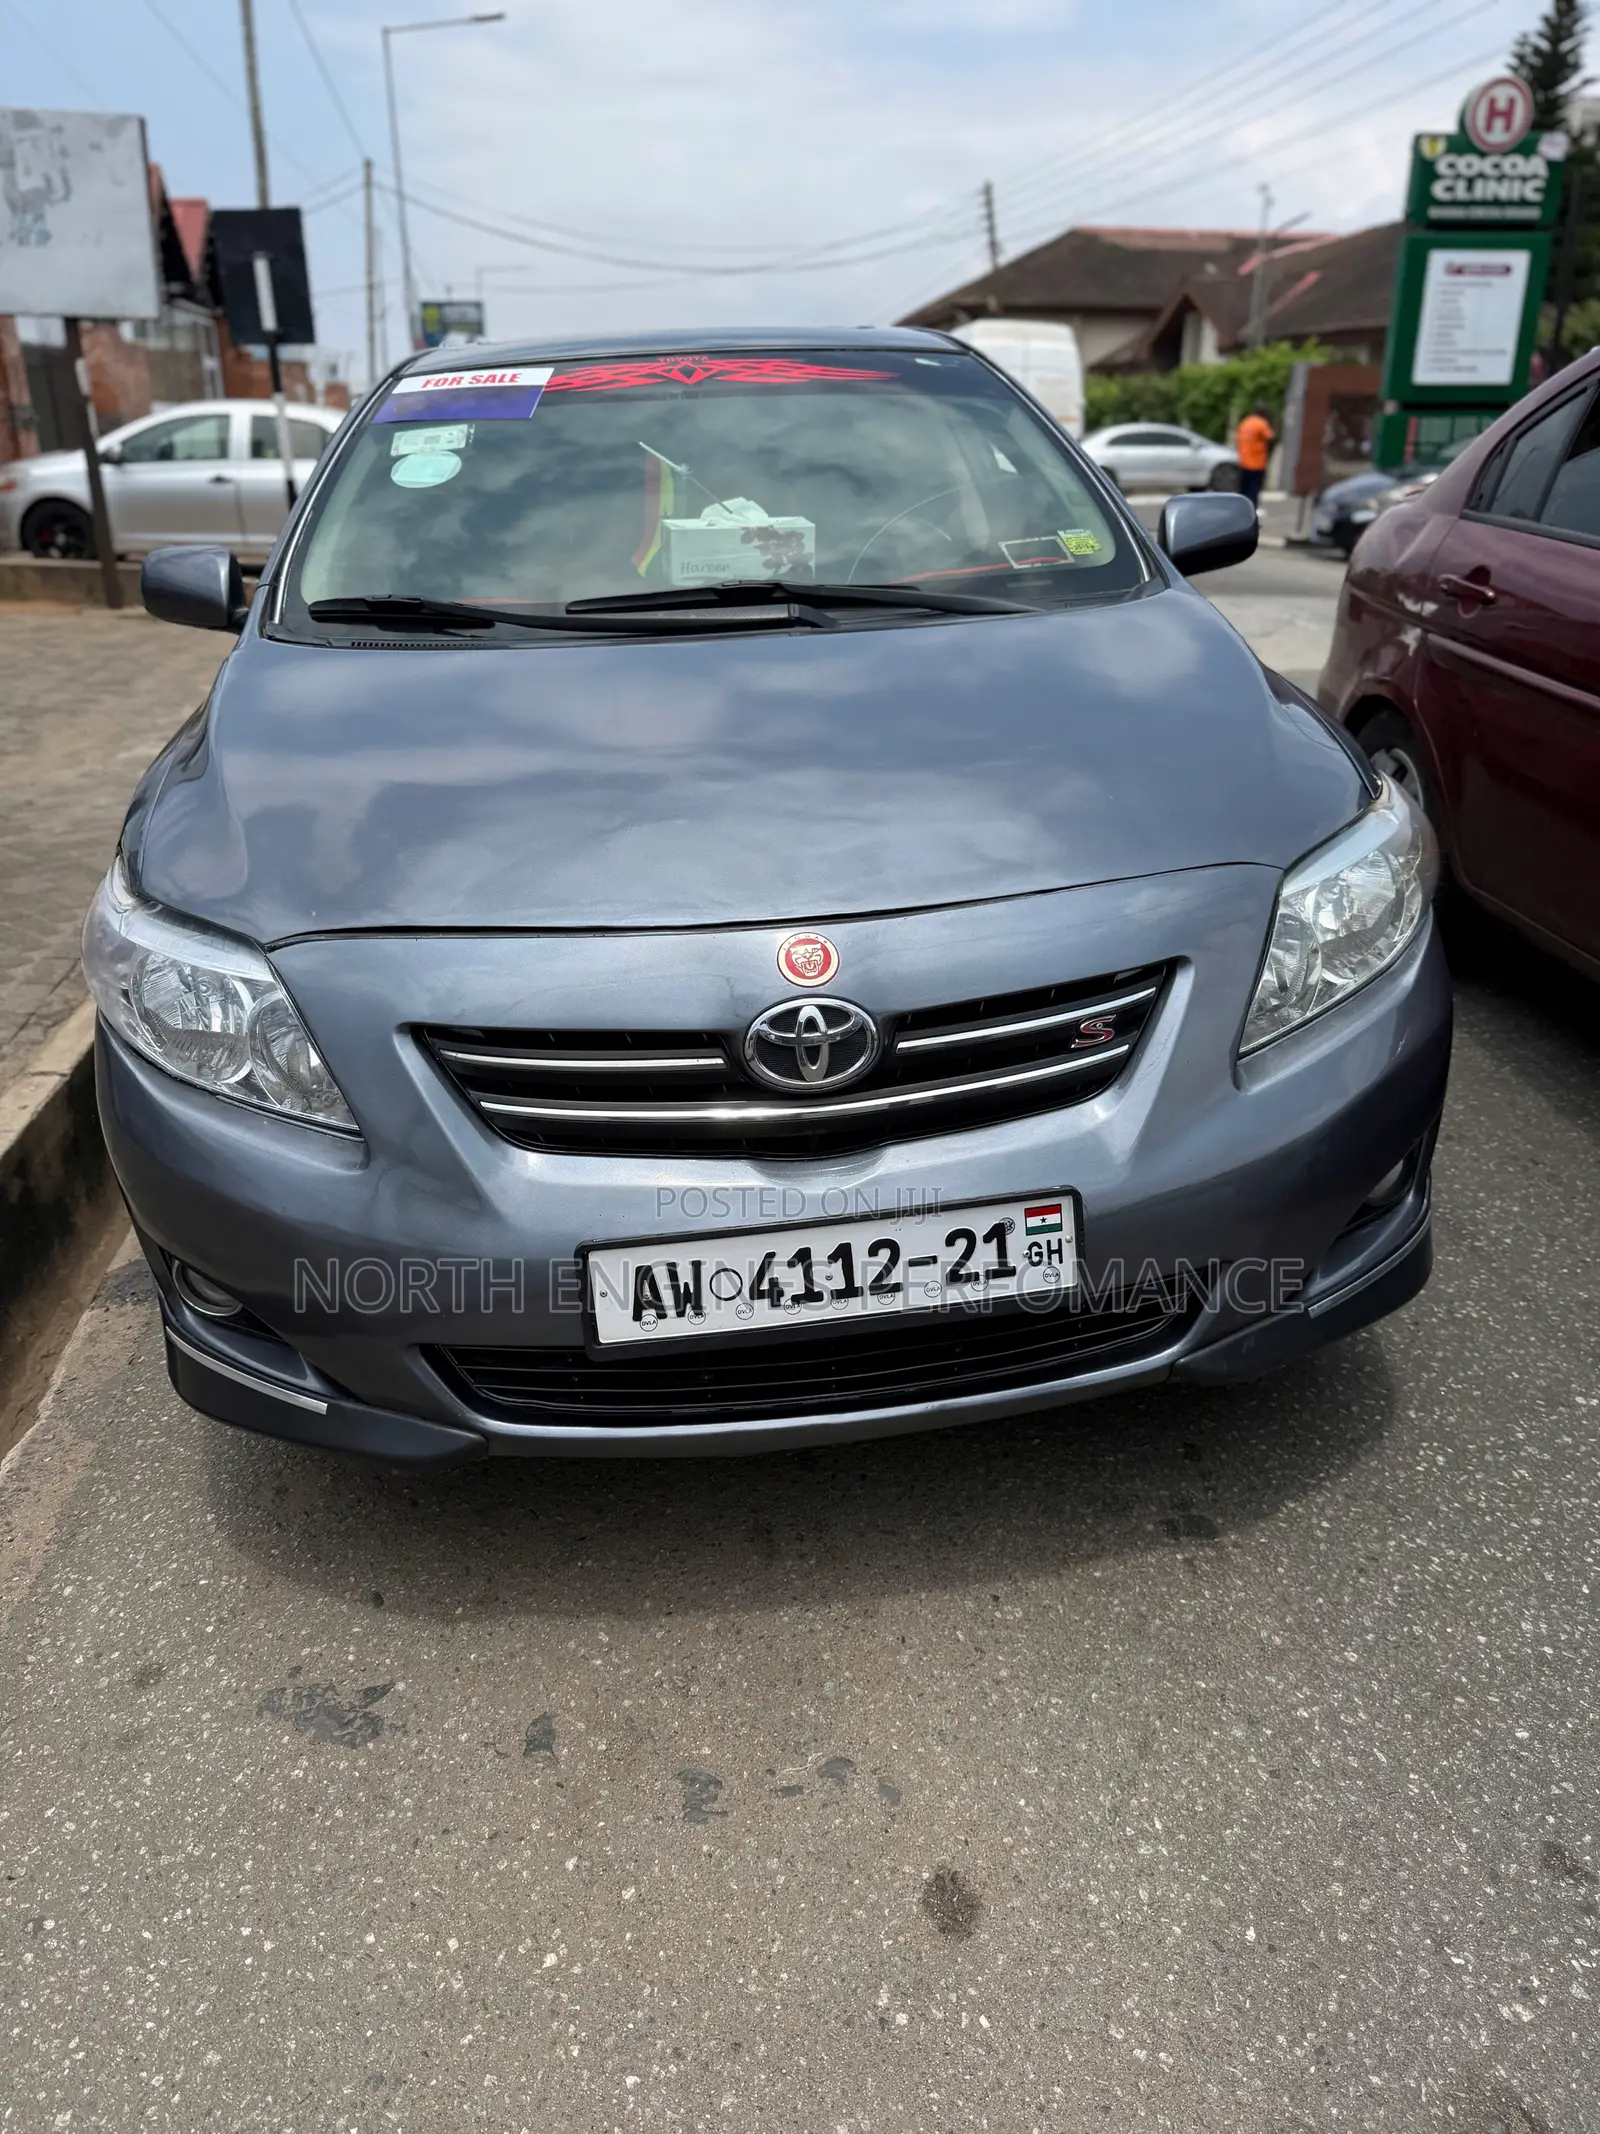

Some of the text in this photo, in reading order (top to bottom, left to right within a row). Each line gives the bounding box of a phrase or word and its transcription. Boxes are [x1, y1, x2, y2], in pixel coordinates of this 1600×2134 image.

[1434, 153, 1549, 178] COCOA
[1430, 177, 1546, 202] CLINIC
[421, 372, 523, 389] FOR SALE
[1070, 1014, 1117, 1049] S
[1027, 1237, 1064, 1268] GH
[632, 1221, 1018, 1322] AW 4112-21
